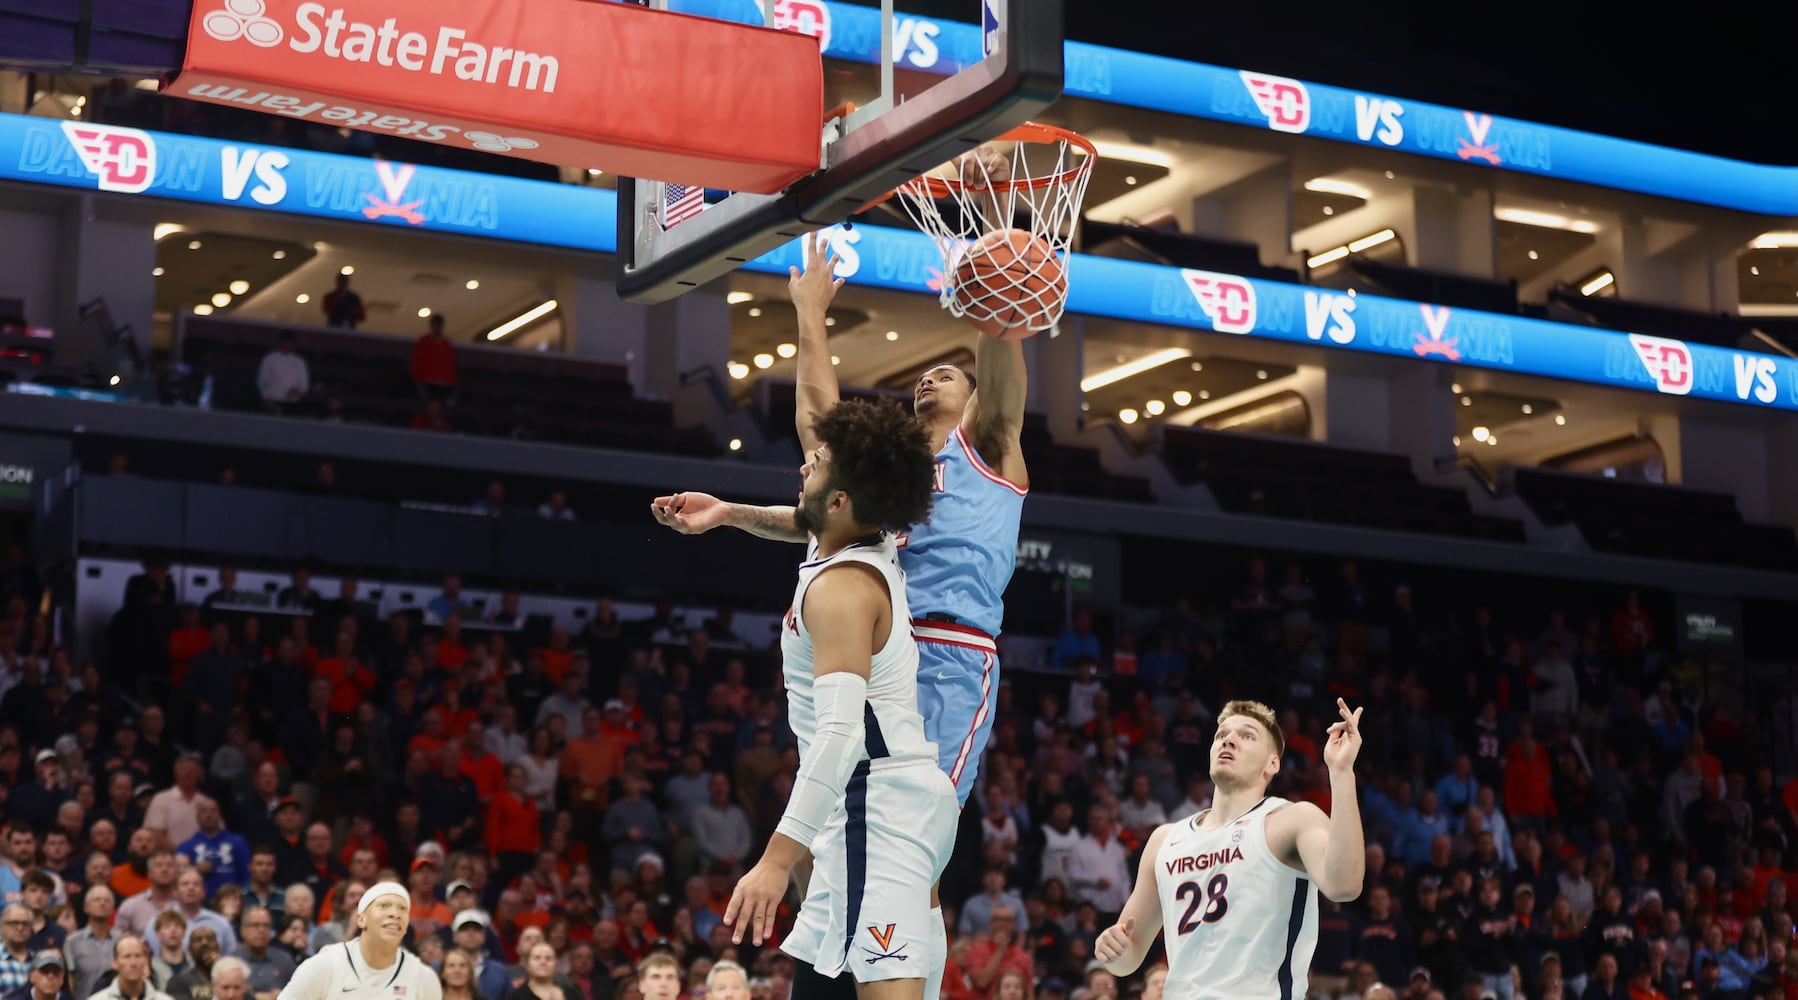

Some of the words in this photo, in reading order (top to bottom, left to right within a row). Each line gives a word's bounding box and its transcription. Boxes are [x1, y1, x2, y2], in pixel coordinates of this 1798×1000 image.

[1354, 95, 1405, 146] VS
[221, 146, 290, 205] VS
[1303, 291, 1357, 344] VS
[1733, 353, 1778, 403] VS
[1166, 845, 1245, 877] VIRGINIA
[1175, 873, 1229, 937] 28
